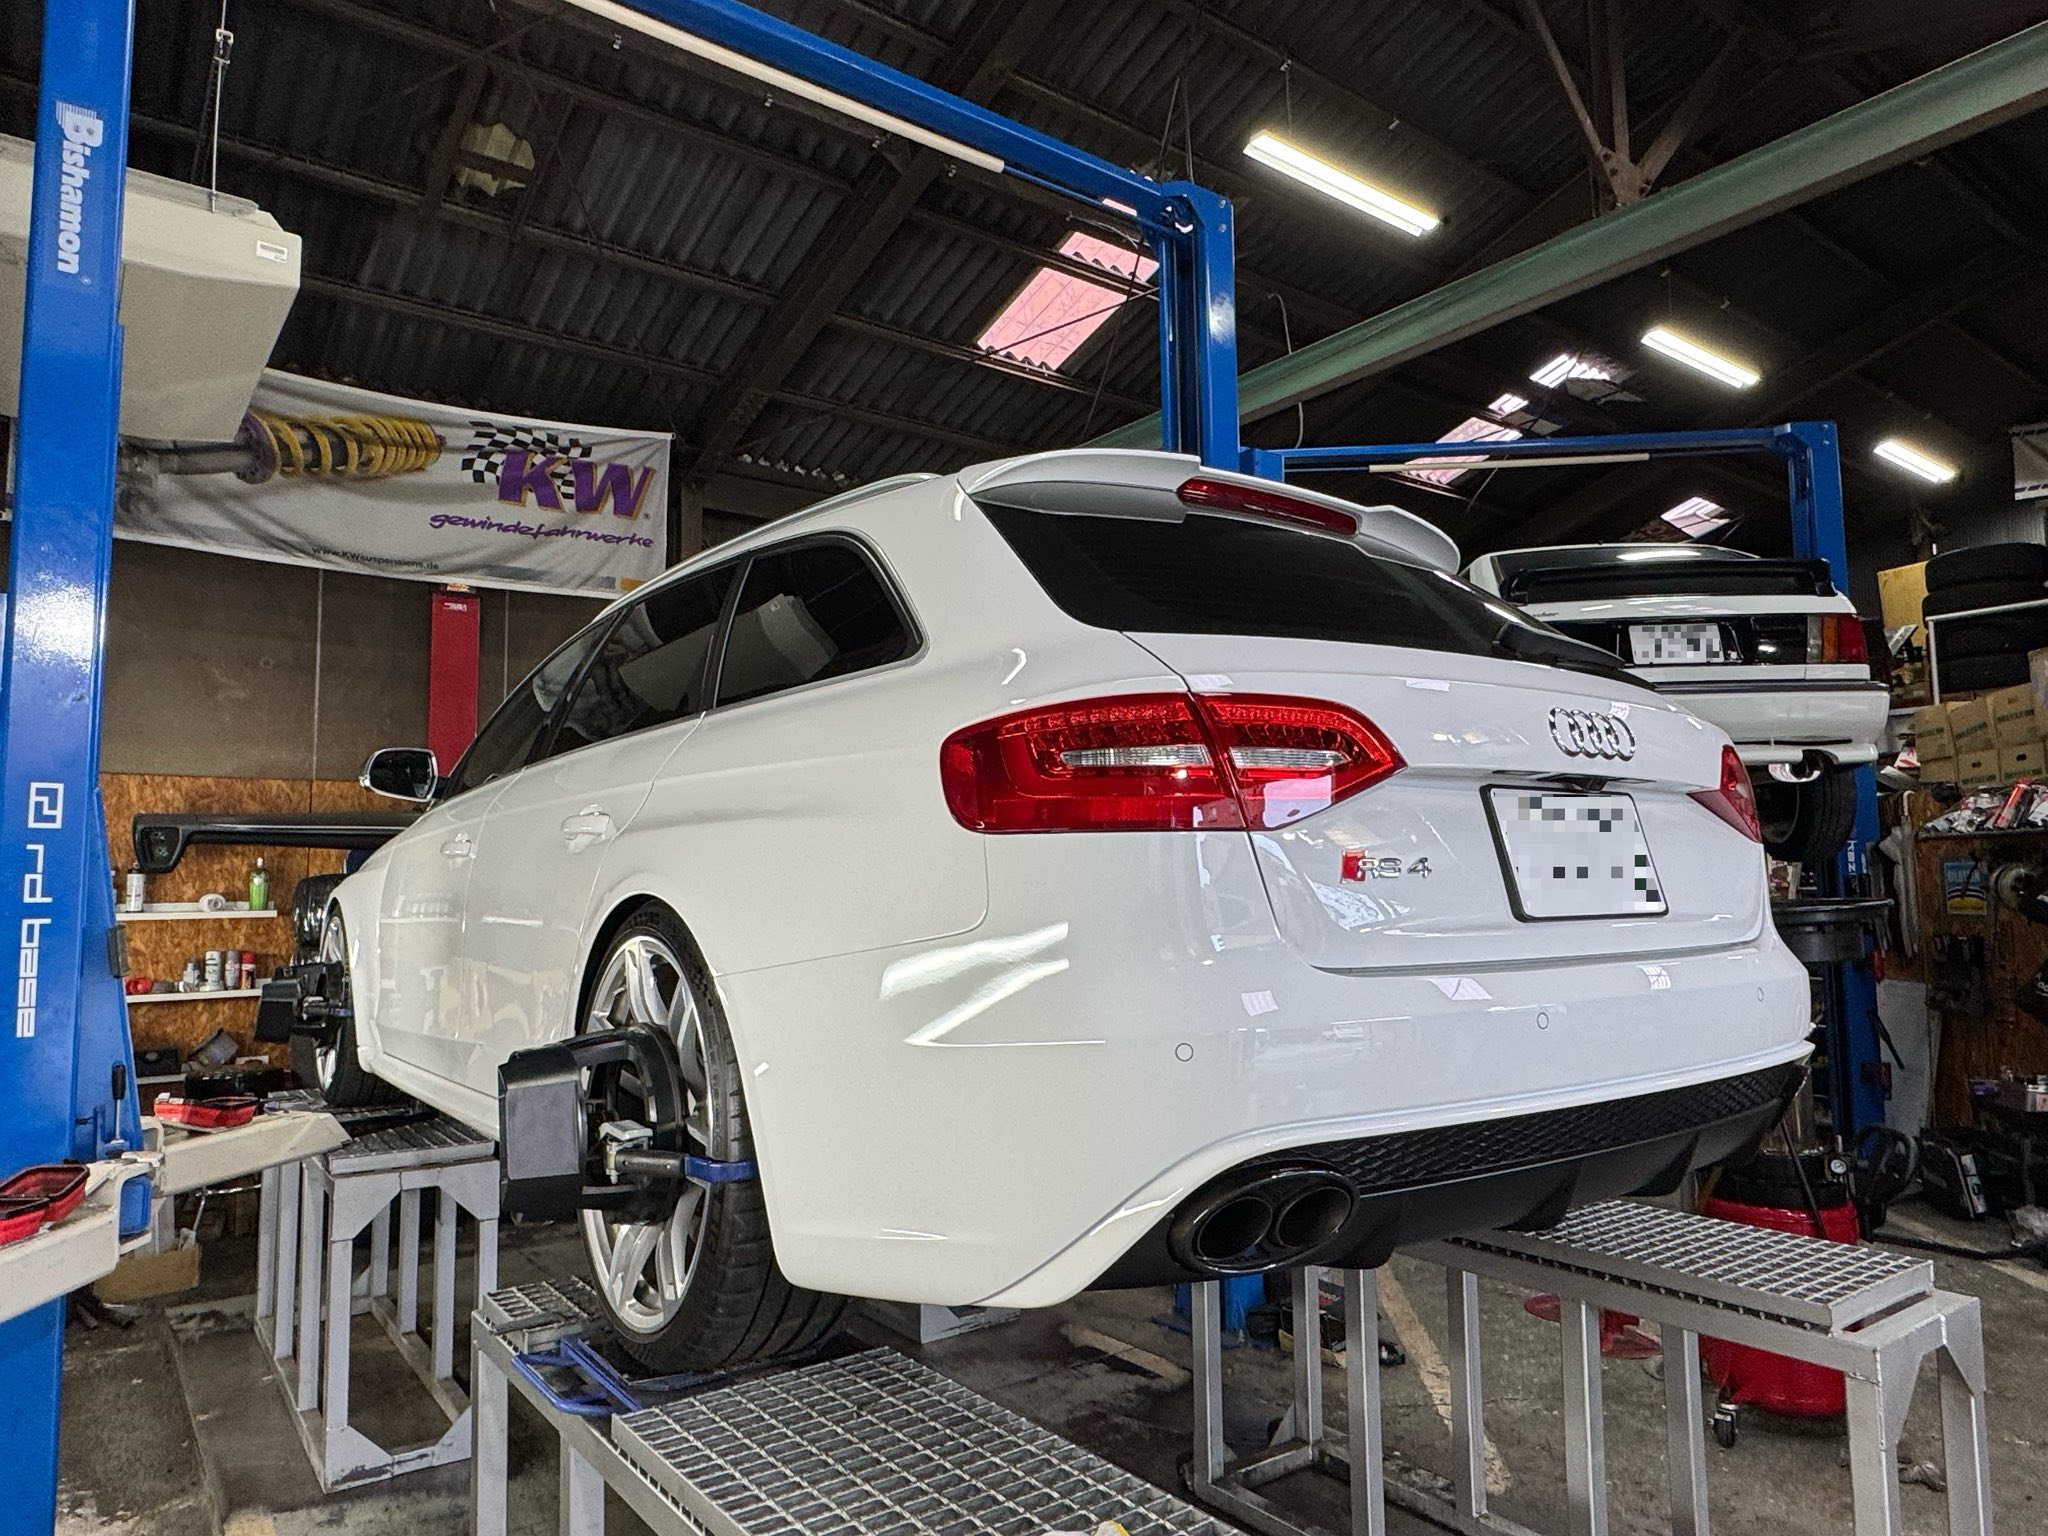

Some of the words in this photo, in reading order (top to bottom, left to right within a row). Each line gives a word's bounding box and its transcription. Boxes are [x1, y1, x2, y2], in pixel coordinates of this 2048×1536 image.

[56, 102, 104, 274] Bishamon
[497, 450, 657, 521] KW
[429, 512, 654, 548] gewindefahrwerke
[1356, 856, 1402, 880] RS
[16, 918, 52, 1039] base
